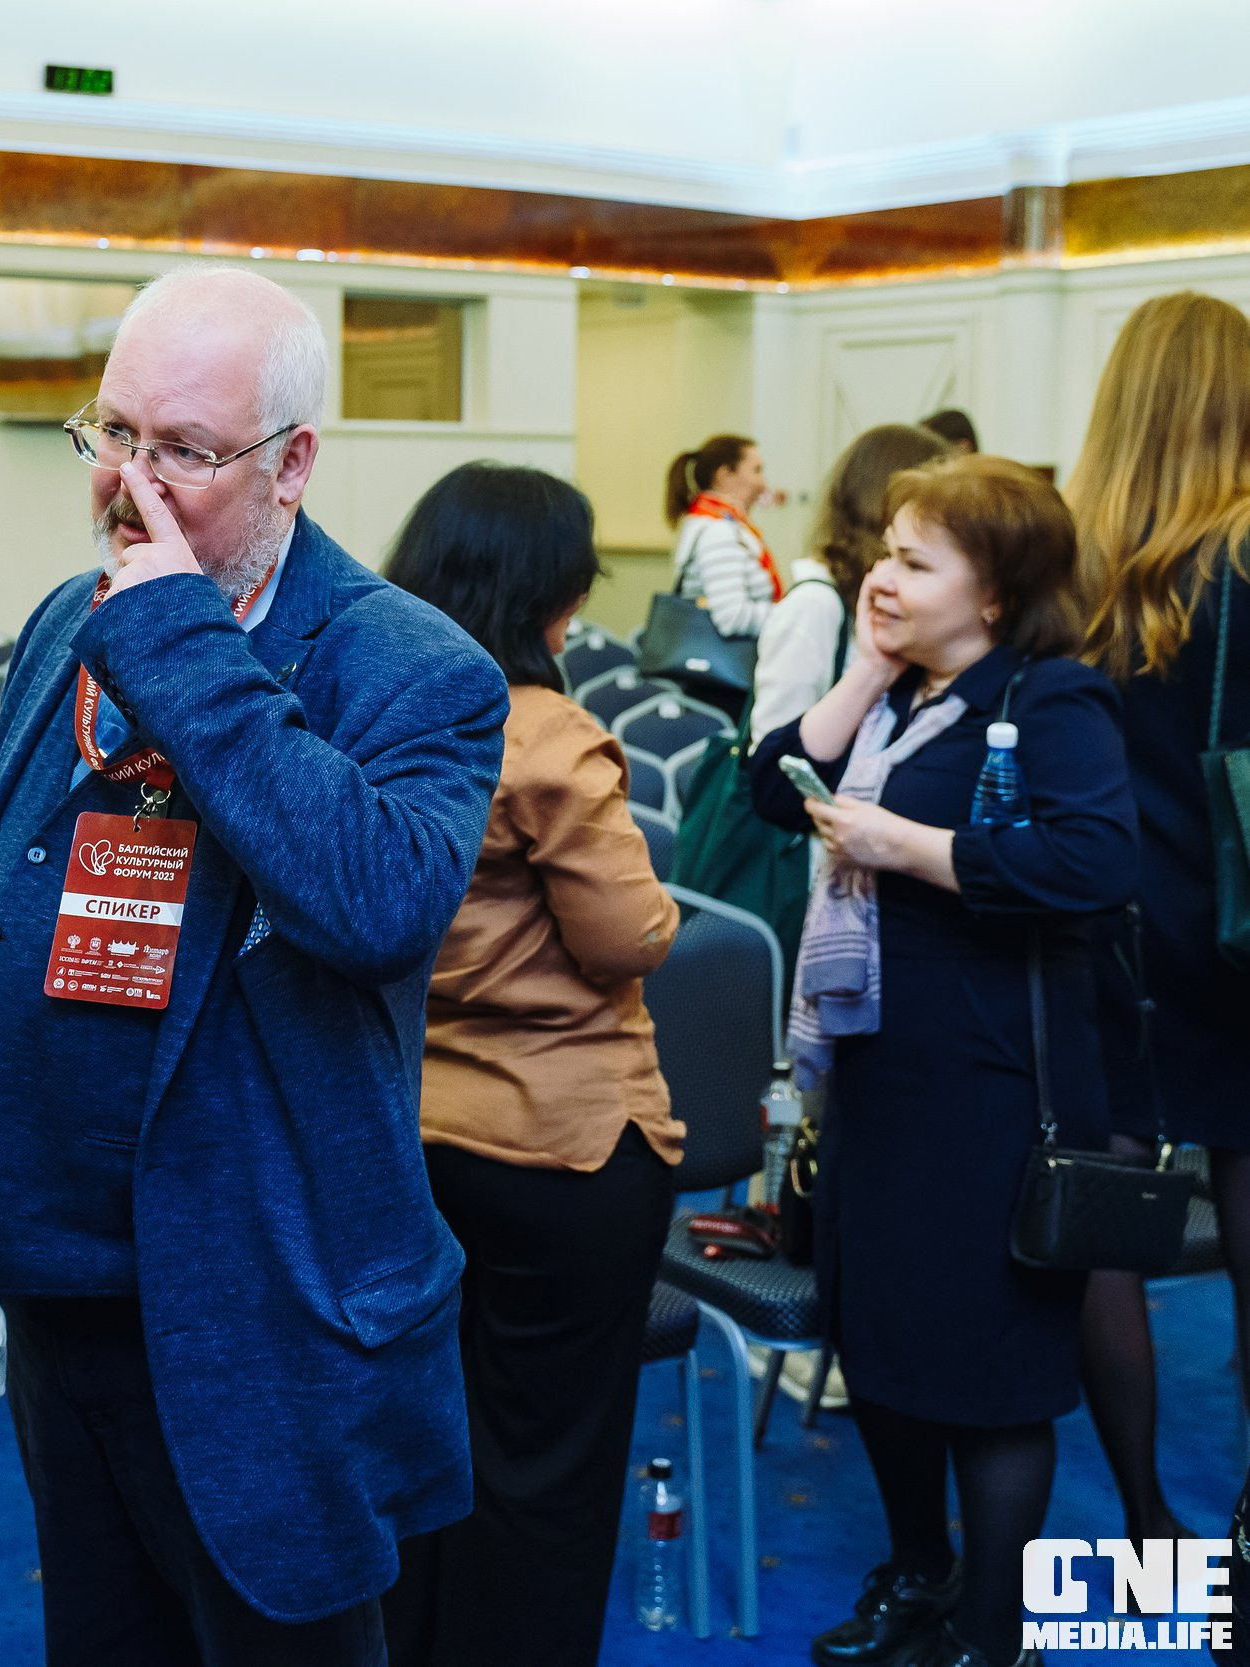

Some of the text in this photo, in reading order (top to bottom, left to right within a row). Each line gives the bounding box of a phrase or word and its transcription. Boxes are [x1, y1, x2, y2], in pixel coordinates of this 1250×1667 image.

[109, 764, 135, 782] КИЙ
[118, 843, 189, 858] БАЛТИЙСКИЙ
[115, 855, 184, 870] КУЛЬТУРНЫЙ
[113, 867, 175, 882] ФОРУМ 2023
[85, 899, 161, 920] СПИКЕР
